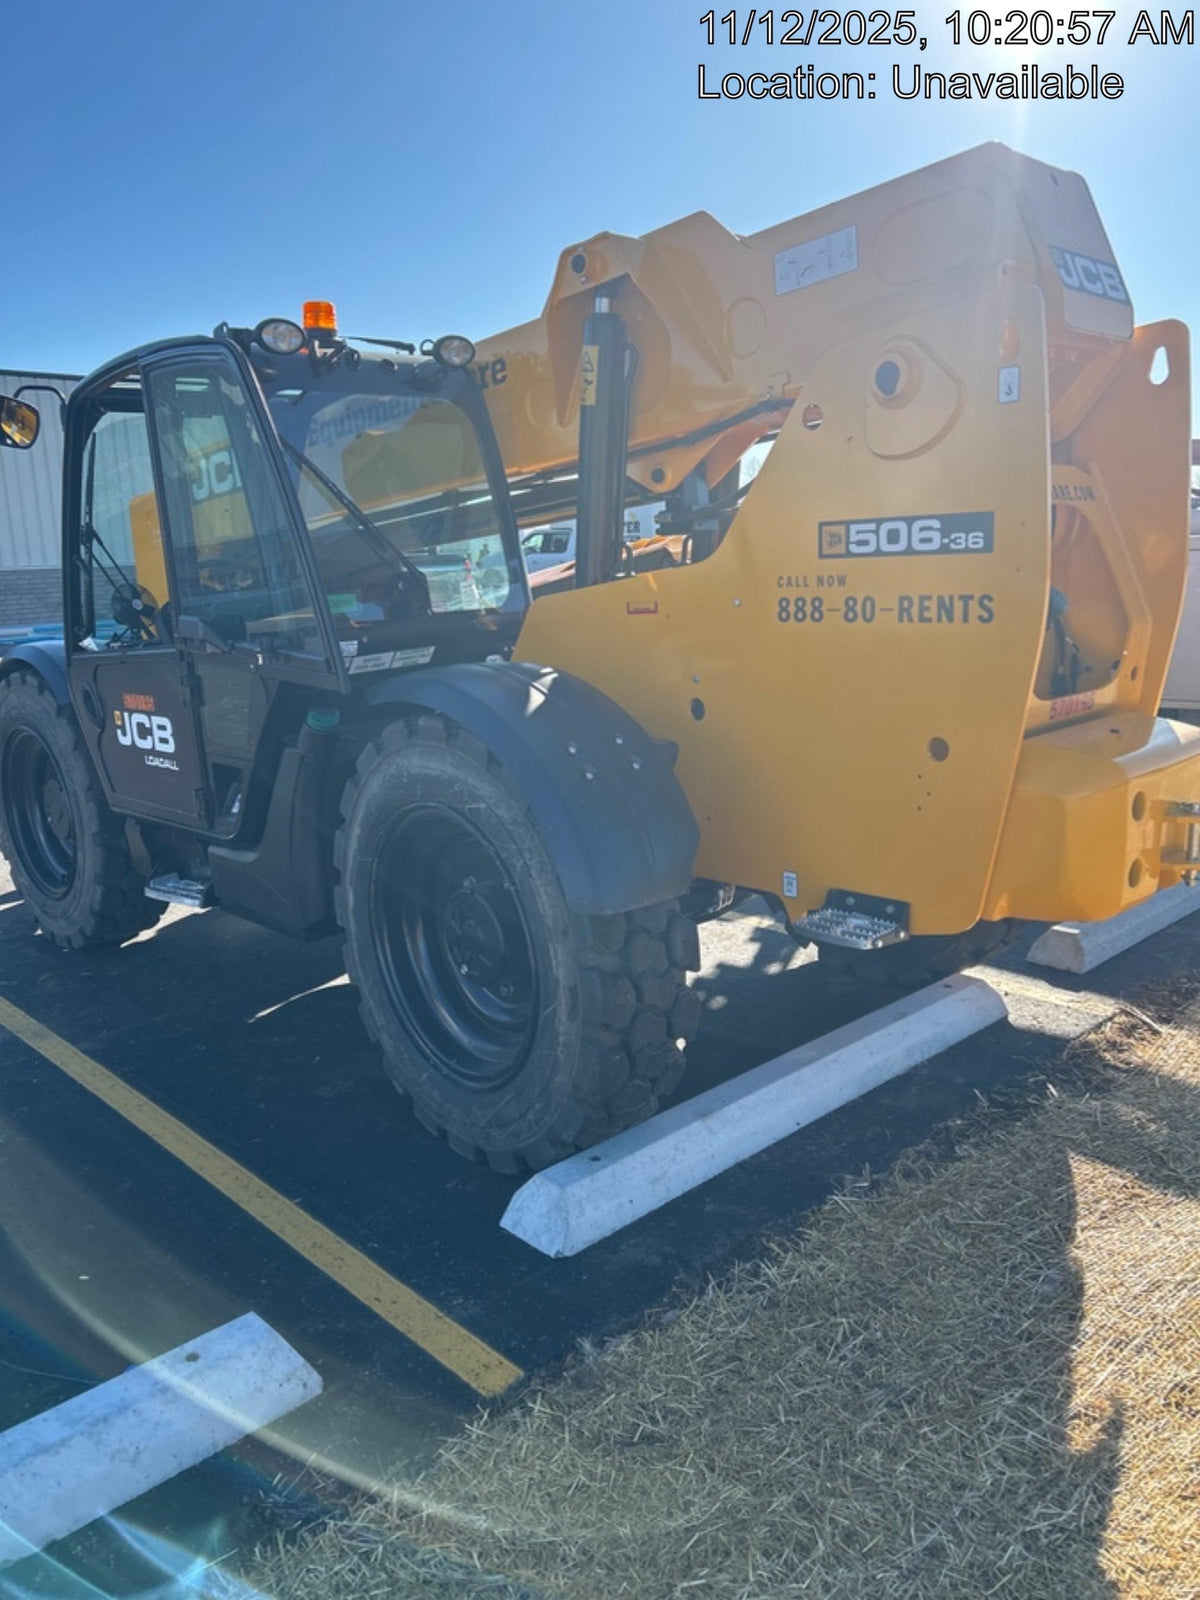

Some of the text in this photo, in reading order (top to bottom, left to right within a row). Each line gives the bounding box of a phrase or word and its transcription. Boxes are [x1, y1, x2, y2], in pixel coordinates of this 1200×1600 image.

[1057, 252, 1127, 301] JCB
[848, 519, 985, 554] 506-36
[777, 574, 848, 588] CALL NOW
[777, 594, 995, 624] 888-80-RENTS
[115, 711, 175, 753] JCB
